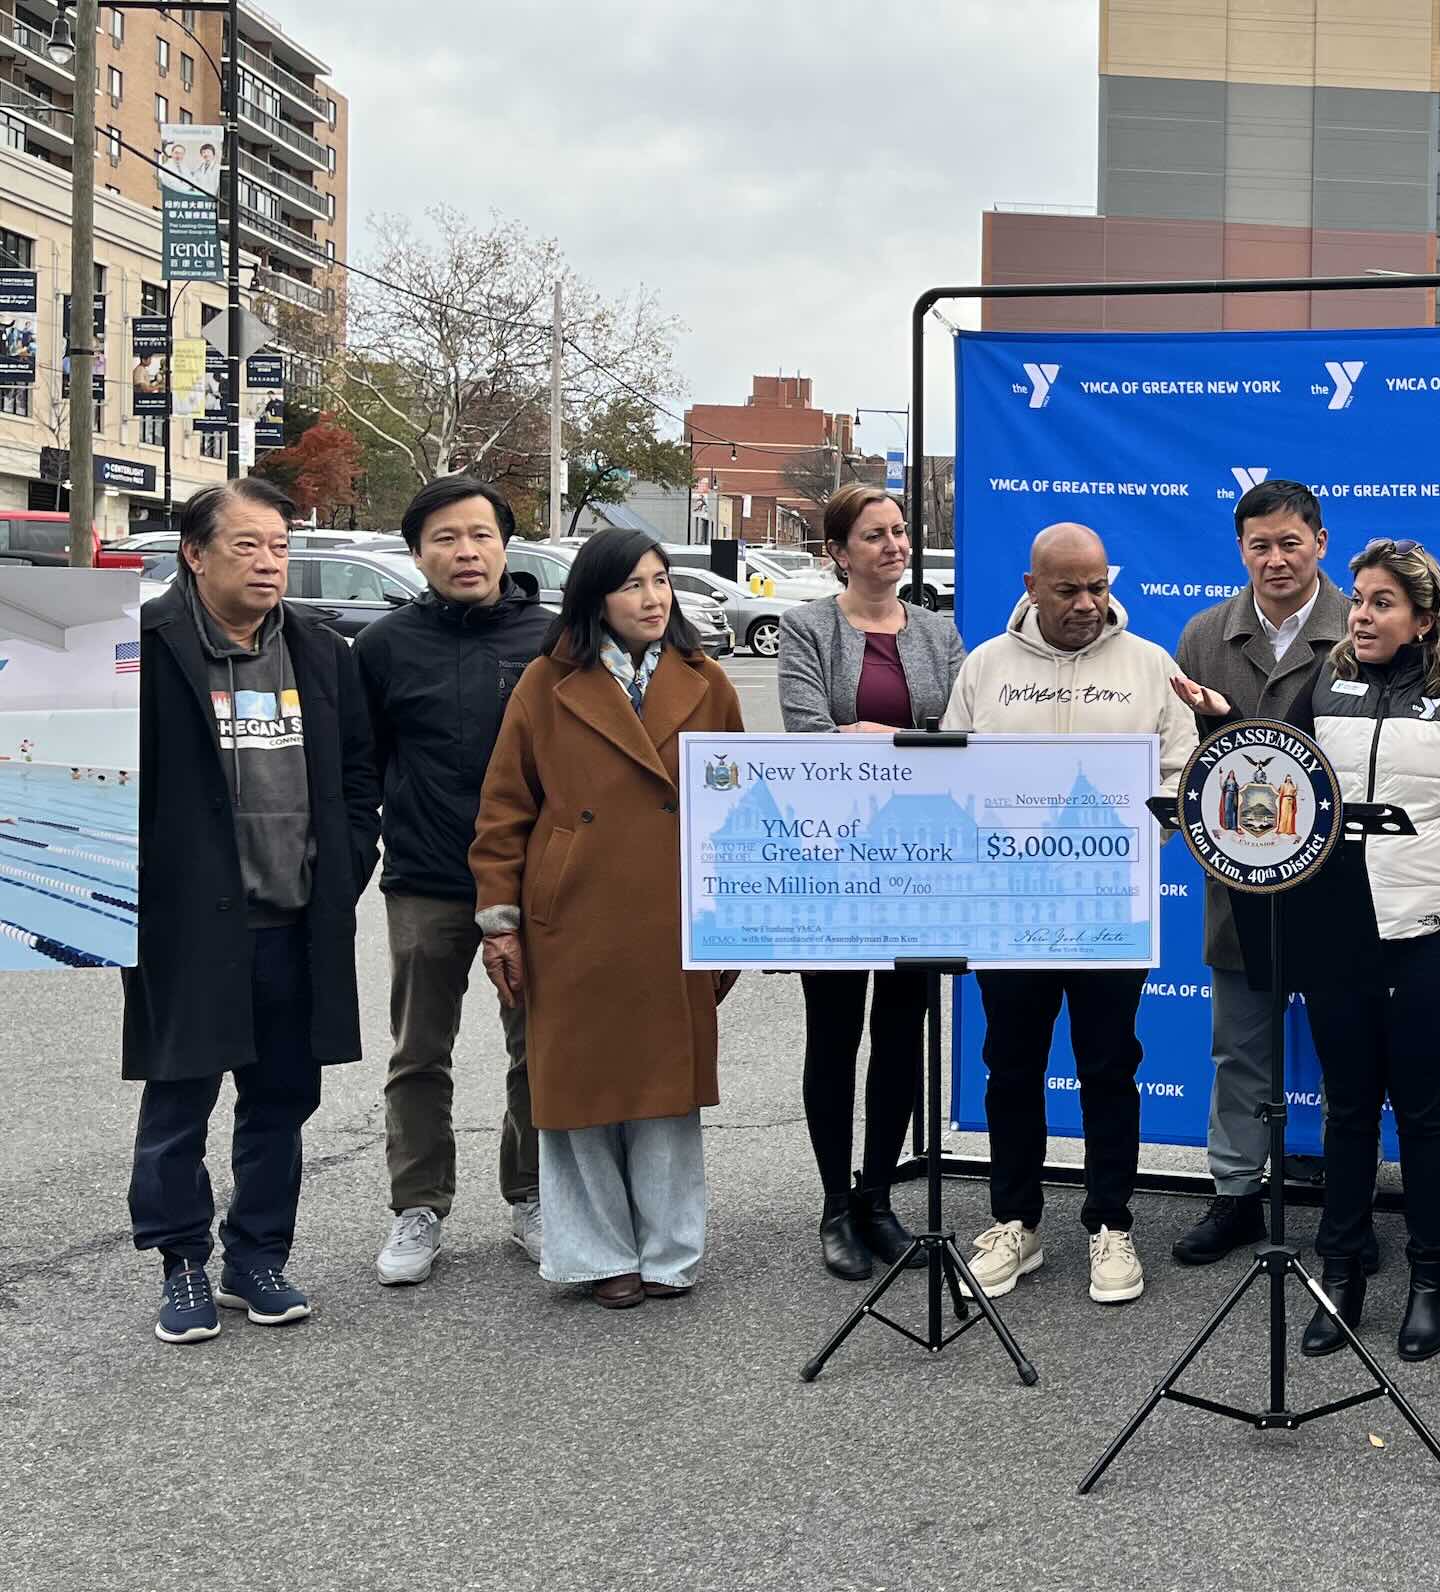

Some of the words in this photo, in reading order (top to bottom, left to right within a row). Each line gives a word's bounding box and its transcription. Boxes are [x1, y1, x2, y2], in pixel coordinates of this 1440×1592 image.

[170, 240, 216, 258] rendr
[1012, 383, 1028, 394] the
[1080, 382, 1119, 395] YMCA
[1122, 382, 1139, 395] OF
[1142, 382, 1203, 394] GREATER
[1207, 381, 1238, 394] NEW
[1242, 380, 1281, 393] YORK
[1311, 384, 1329, 395] the
[1385, 377, 1427, 391] YMCA
[110, 463, 145, 477] CENTERLIGHT
[989, 478, 1029, 492] YMCA
[1032, 479, 1050, 493] OF
[1052, 481, 1115, 495] GREATER
[1118, 483, 1147, 496] NEW
[1150, 483, 1189, 497] YORK
[1216, 488, 1235, 499] the
[1306, 484, 1329, 497] CA
[1332, 484, 1350, 497] OF
[1353, 484, 1417, 497] GREATER
[1140, 583, 1180, 596] YMCA
[1184, 584, 1201, 597] OF
[1205, 586, 1245, 598] GREA
[1082, 684, 1132, 704] Bronx
[217, 720, 286, 736] HEGAN
[1200, 736, 1233, 770] NYS
[1234, 728, 1322, 775] ASSEMBLY
[747, 762, 796, 781] New
[800, 762, 852, 781] York
[858, 762, 913, 781] State
[985, 798, 1012, 807] DATE:
[1015, 793, 1079, 806] November
[1081, 794, 1097, 808] 20,
[1101, 794, 1130, 806] 2025
[761, 819, 832, 838] YMCA
[837, 818, 861, 838] of
[720, 842, 735, 851] TO
[762, 843, 845, 862] Greater
[850, 843, 897, 862] New
[902, 842, 953, 862] York
[986, 832, 1130, 861] $3,000,000
[1189, 821, 1211, 859] Ron
[1208, 856, 1244, 883] Kim,
[1248, 867, 1277, 883] 40th
[1280, 833, 1326, 880] District
[703, 876, 762, 894] Three
[767, 876, 839, 894] Million
[845, 876, 881, 894] and
[1159, 884, 1188, 897] ORK
[797, 925, 822, 933] YMCA
[825, 935, 882, 946] Assemblyman
[883, 935, 899, 943] Ron
[901, 935, 918, 943] Kim
[1180, 984, 1198, 997] OF
[1047, 1077, 1082, 1091] GREA
[1146, 1082, 1184, 1097] YORK
